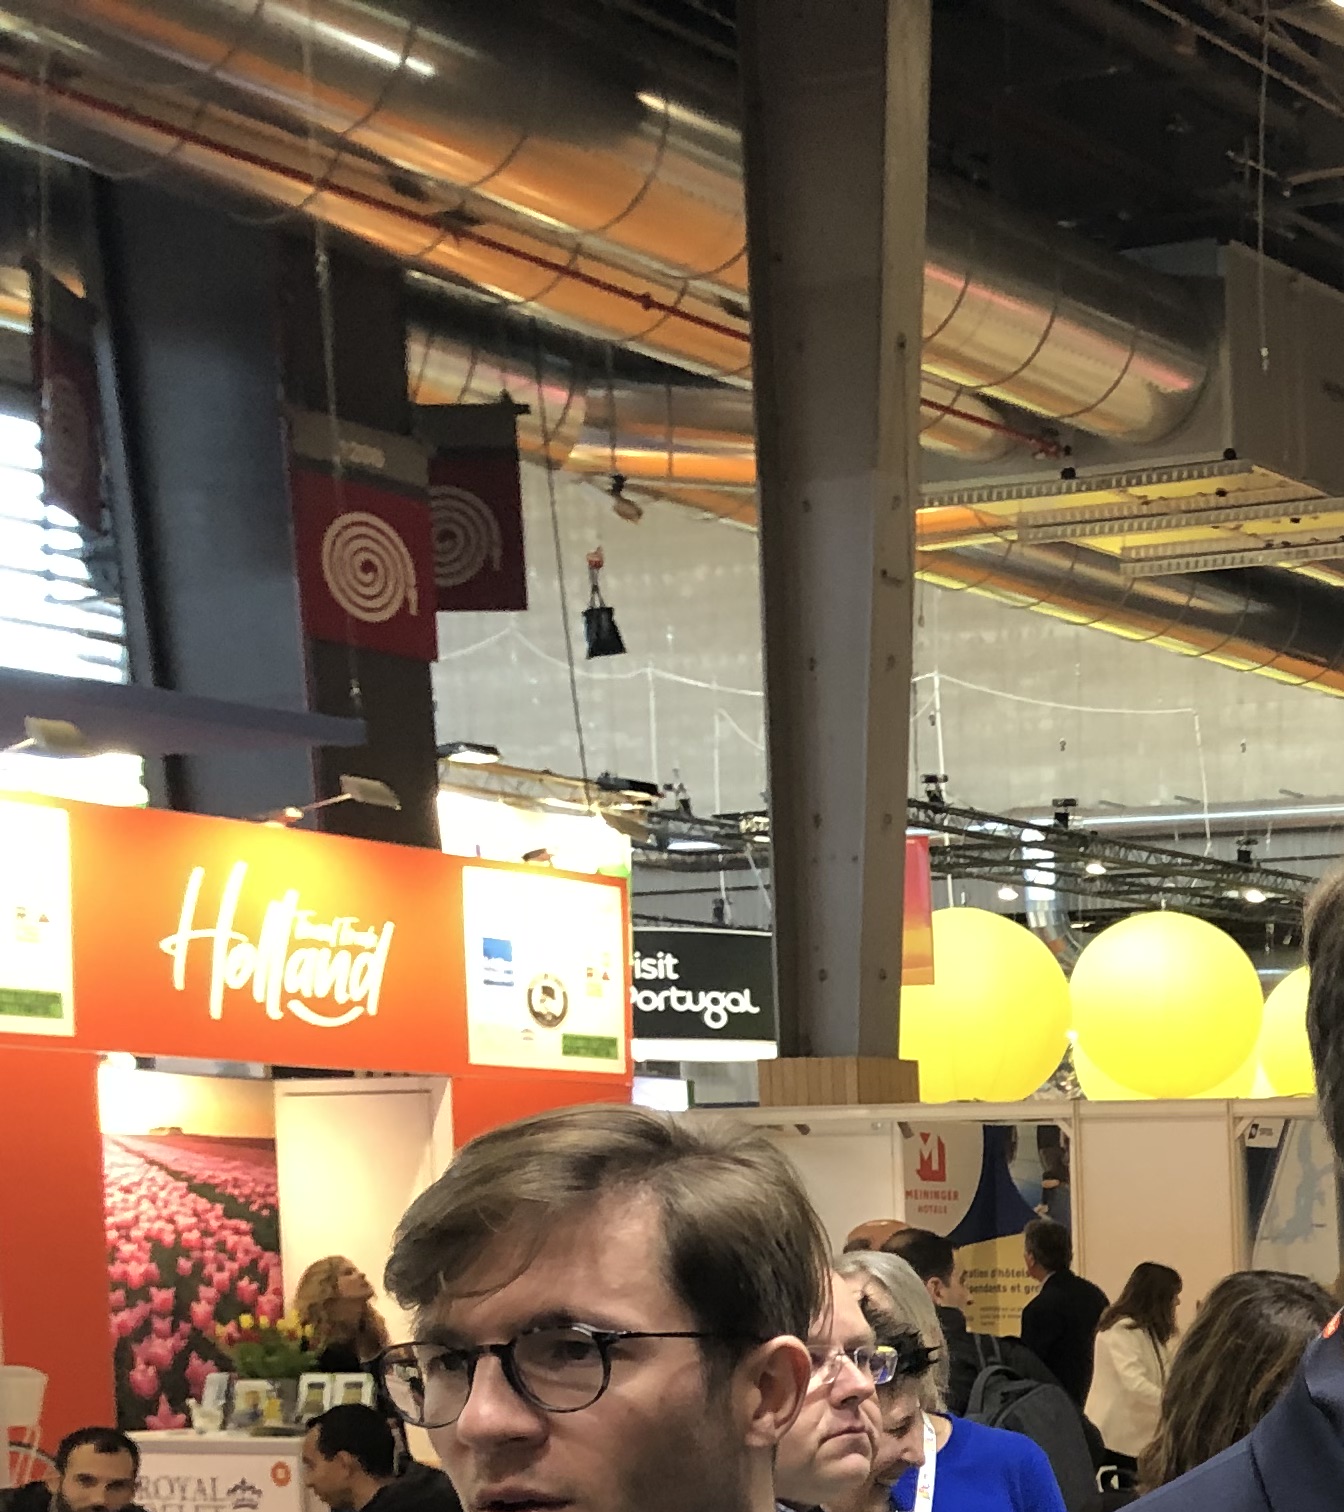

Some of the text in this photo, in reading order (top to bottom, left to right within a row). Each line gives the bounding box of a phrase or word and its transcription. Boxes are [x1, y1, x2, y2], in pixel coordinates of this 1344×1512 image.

[159, 860, 395, 1021] Holland
[905, 1188, 960, 1201] MEININGER
[917, 1204, 948, 1215] HOTELS
[1010, 1283, 1021, 1293] et
